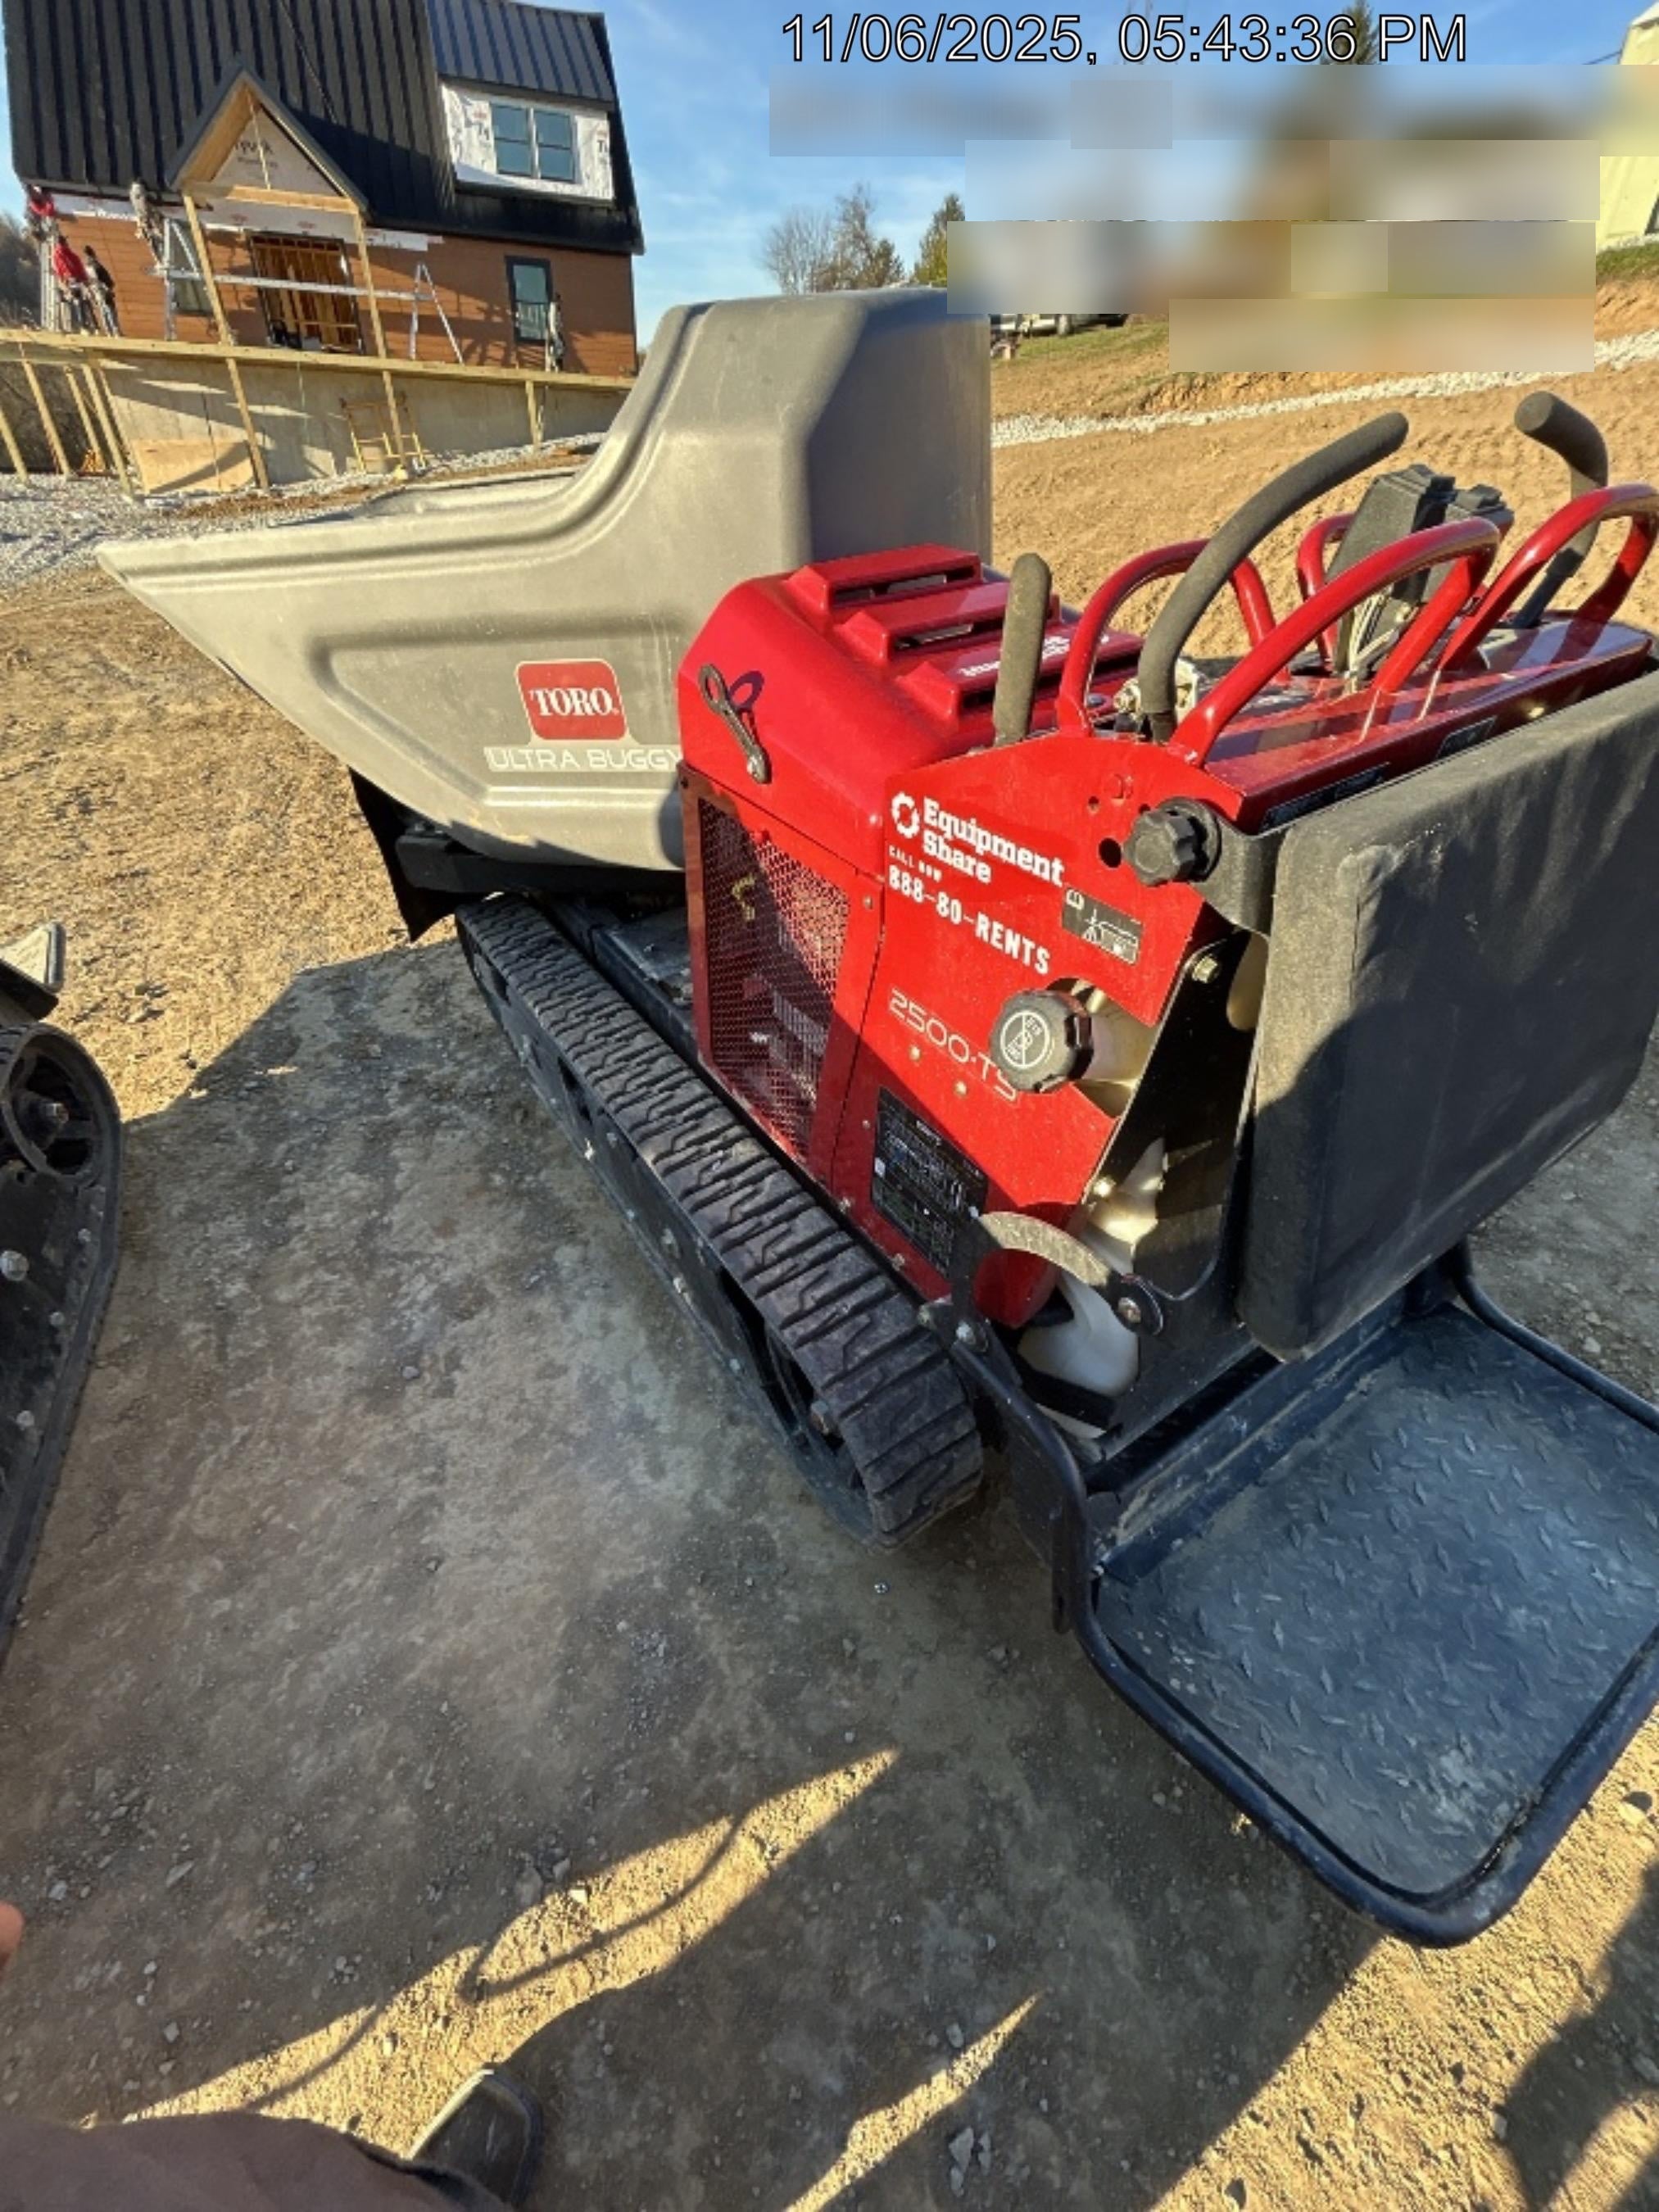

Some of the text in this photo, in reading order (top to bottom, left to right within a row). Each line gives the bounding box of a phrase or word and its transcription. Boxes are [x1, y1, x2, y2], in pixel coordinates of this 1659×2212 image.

[528, 687, 614, 717] TORO
[485, 747, 683, 770] ULTRA BUGGY
[923, 832, 991, 884] Share
[924, 797, 1064, 887] Equipment
[889, 865, 1049, 975] 888-80-RENTS
